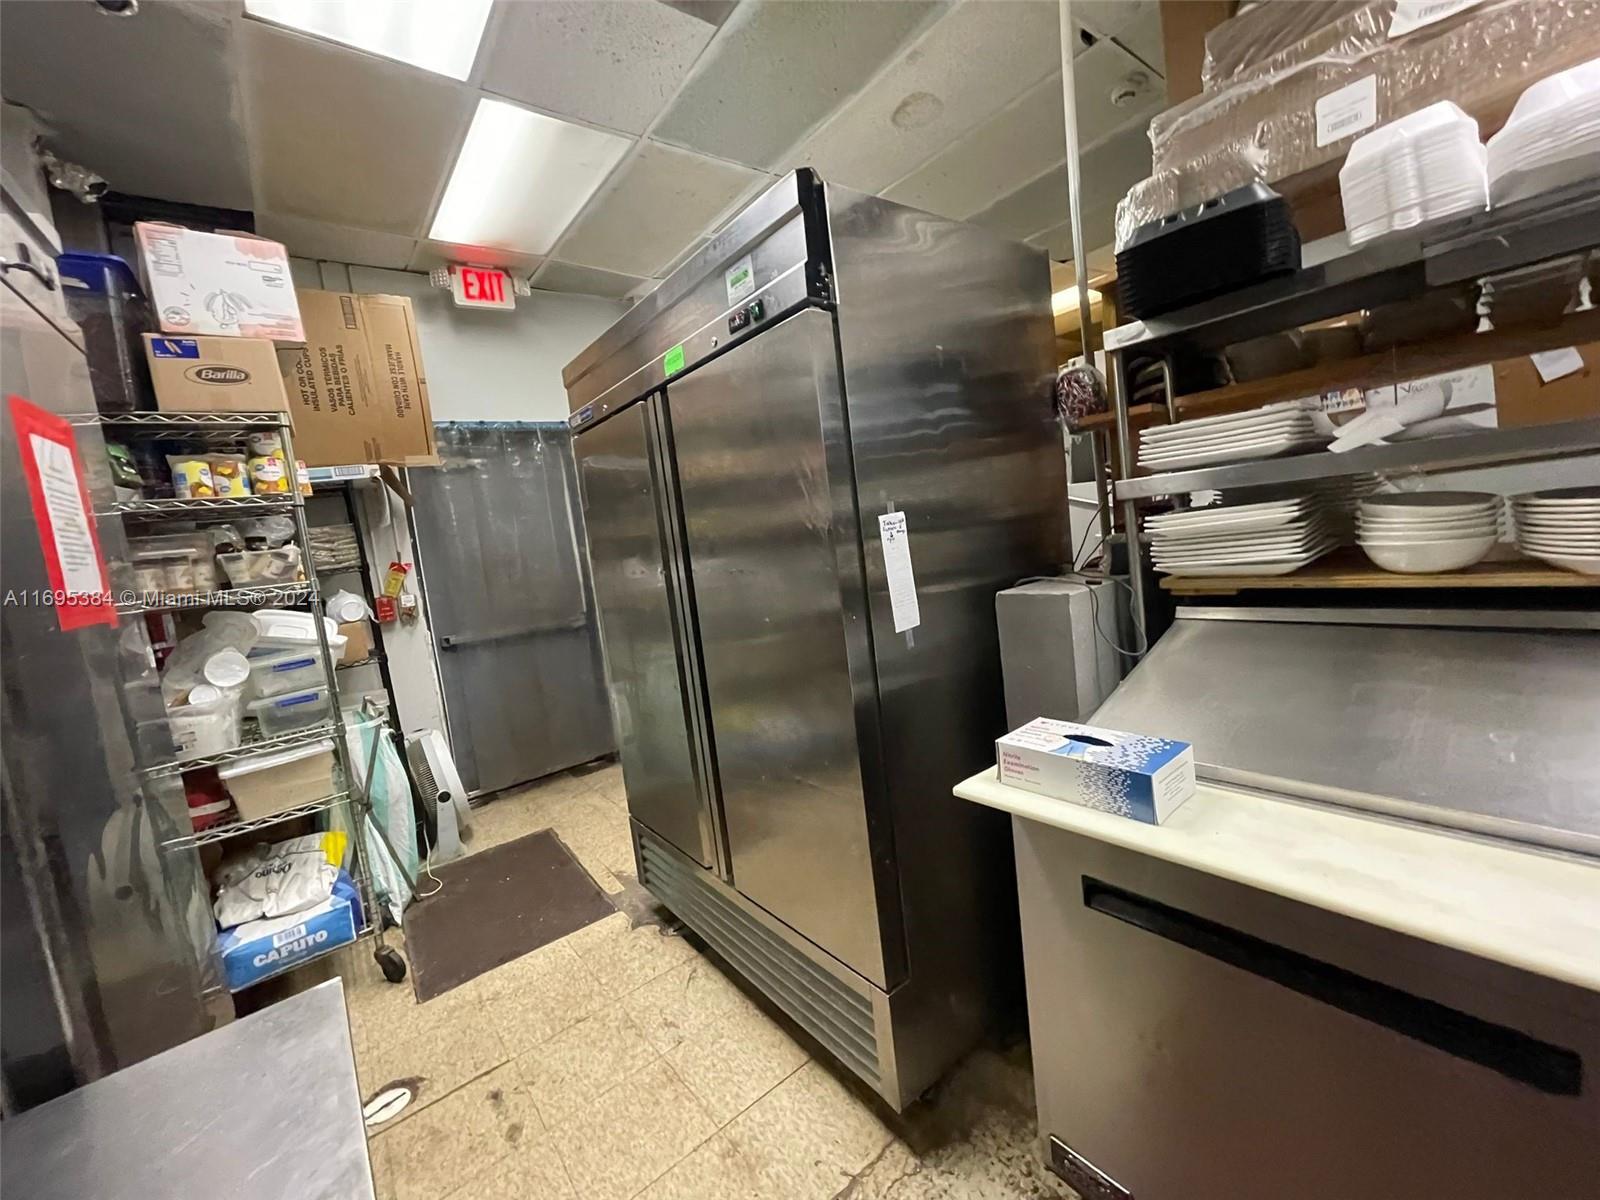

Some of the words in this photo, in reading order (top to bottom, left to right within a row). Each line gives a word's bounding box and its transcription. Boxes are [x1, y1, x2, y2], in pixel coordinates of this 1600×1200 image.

[462, 268, 505, 302] EXIT
[302, 347, 311, 368] CUPS
[336, 344, 346, 366] FRIAS
[394, 352, 406, 375] HANDLE
[201, 369, 246, 381] Barilla
[319, 347, 333, 386] TERMICOS
[328, 353, 342, 386] BEBIDAS
[298, 376, 308, 388] OR
[307, 370, 320, 412] INSULATED
[391, 376, 399, 389] CON
[399, 376, 408, 393] WITH
[300, 389, 311, 405] HOT
[326, 388, 338, 412] VASOS
[336, 387, 346, 407] PARA
[341, 375, 355, 415] CALIENTES
[393, 390, 405, 418] CUIDADO
[402, 393, 412, 410] CARE
[253, 929, 328, 967] CAPUTO
